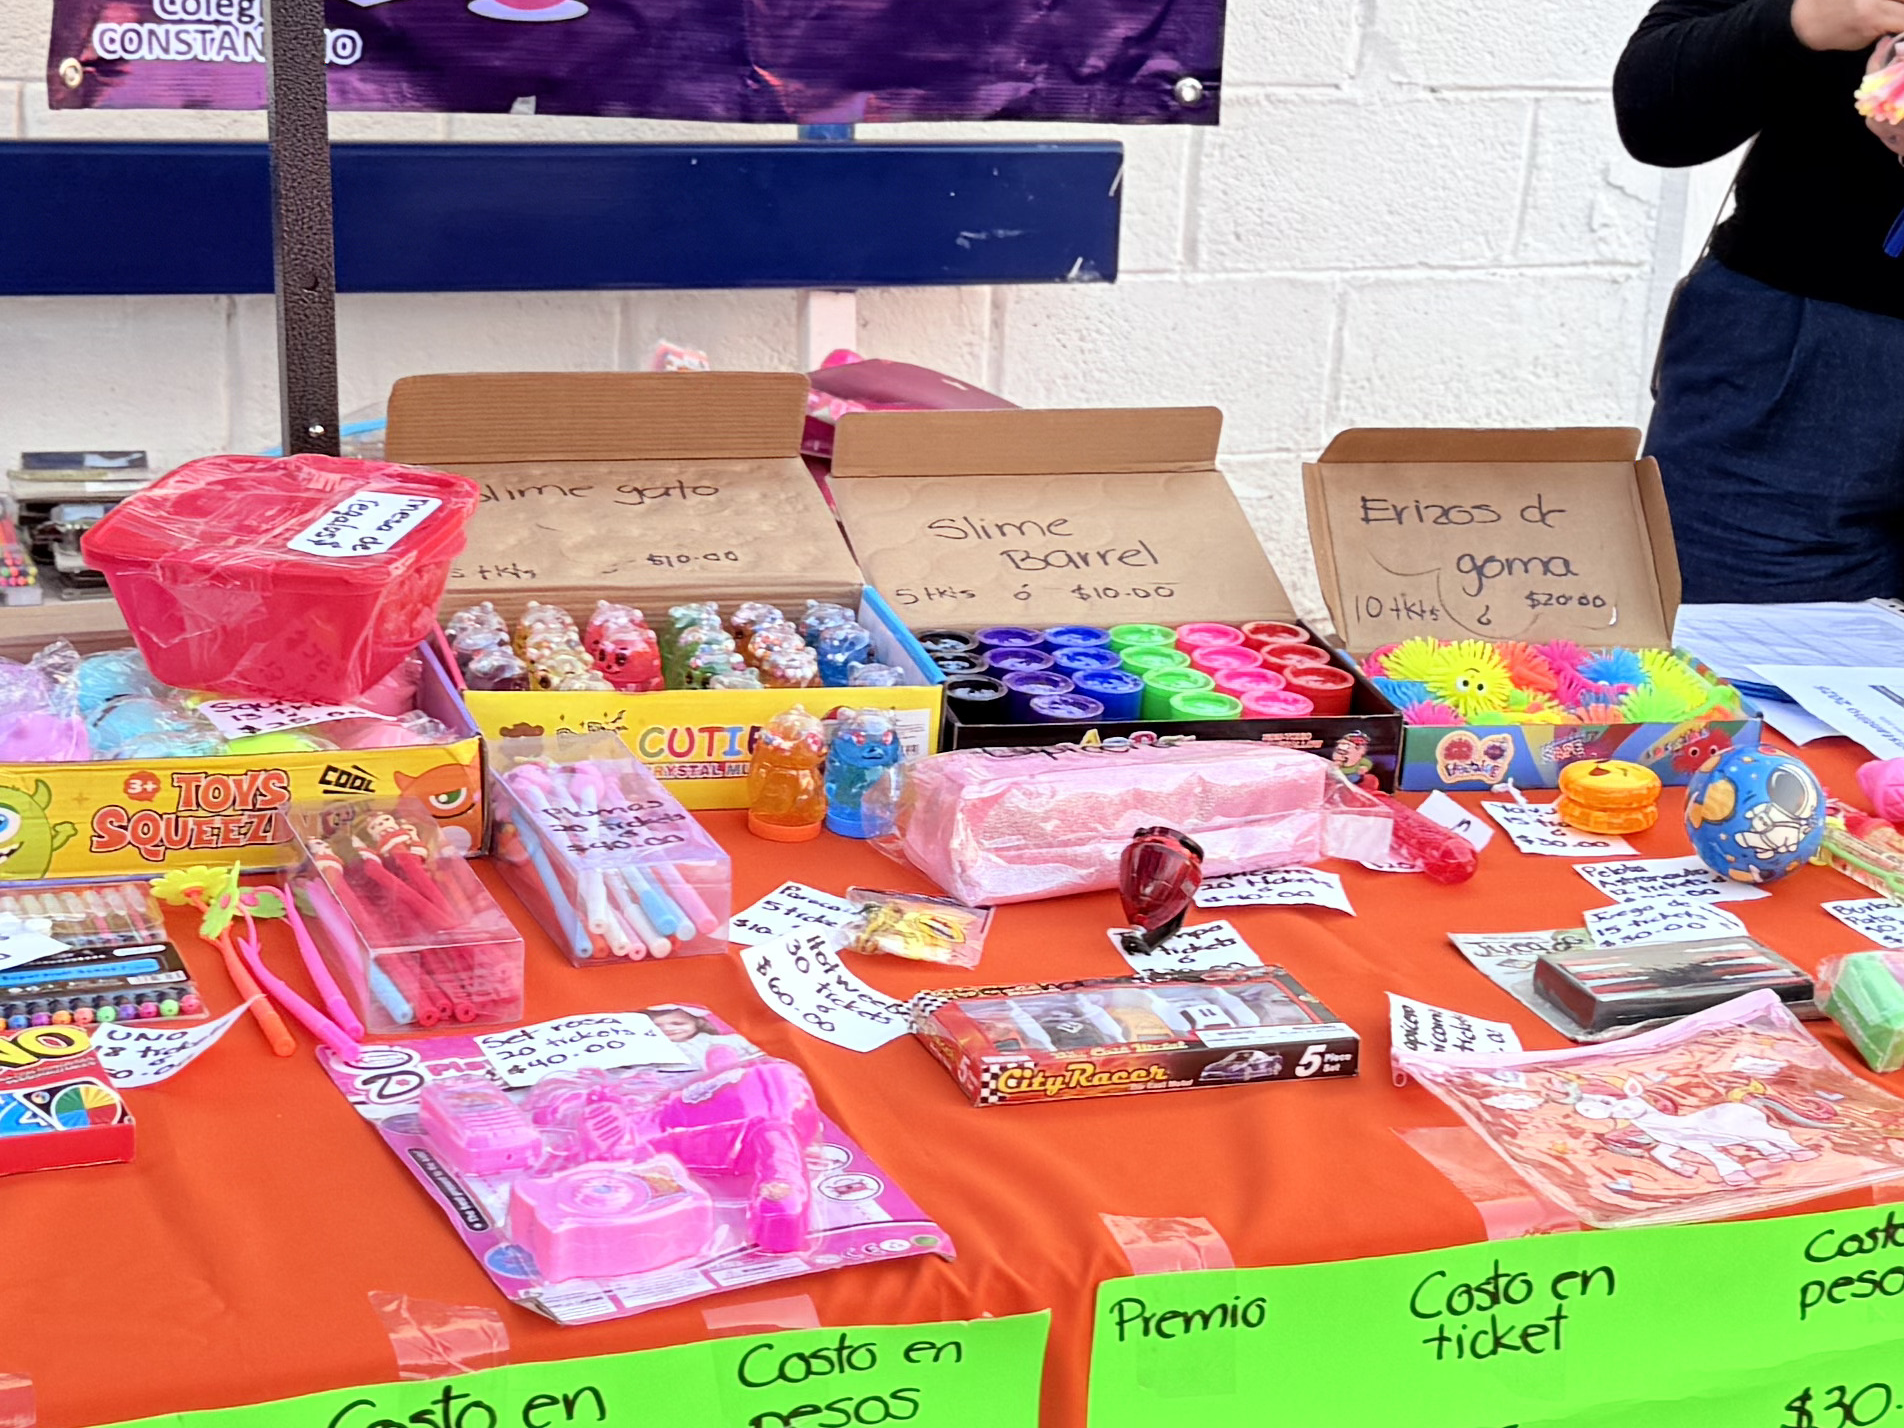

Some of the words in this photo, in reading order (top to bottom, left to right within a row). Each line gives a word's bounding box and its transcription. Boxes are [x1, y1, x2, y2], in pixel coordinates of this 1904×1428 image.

[1361, 496, 1501, 525] Erizos
[928, 516, 1072, 540] Slime
[1000, 540, 1158, 571] Barrel
[1454, 552, 1580, 597] goma
[1069, 580, 1179, 604] $10.00
[171, 769, 291, 811] TOYS
[107, 1030, 187, 1041] UNO
[1294, 1045, 1326, 1076] 5
[1410, 1260, 1533, 1319] Costo
[1551, 1266, 1615, 1300] en
[1423, 1304, 1568, 1360] ticket
[738, 1333, 877, 1388] Costo
[902, 1336, 964, 1366] en
